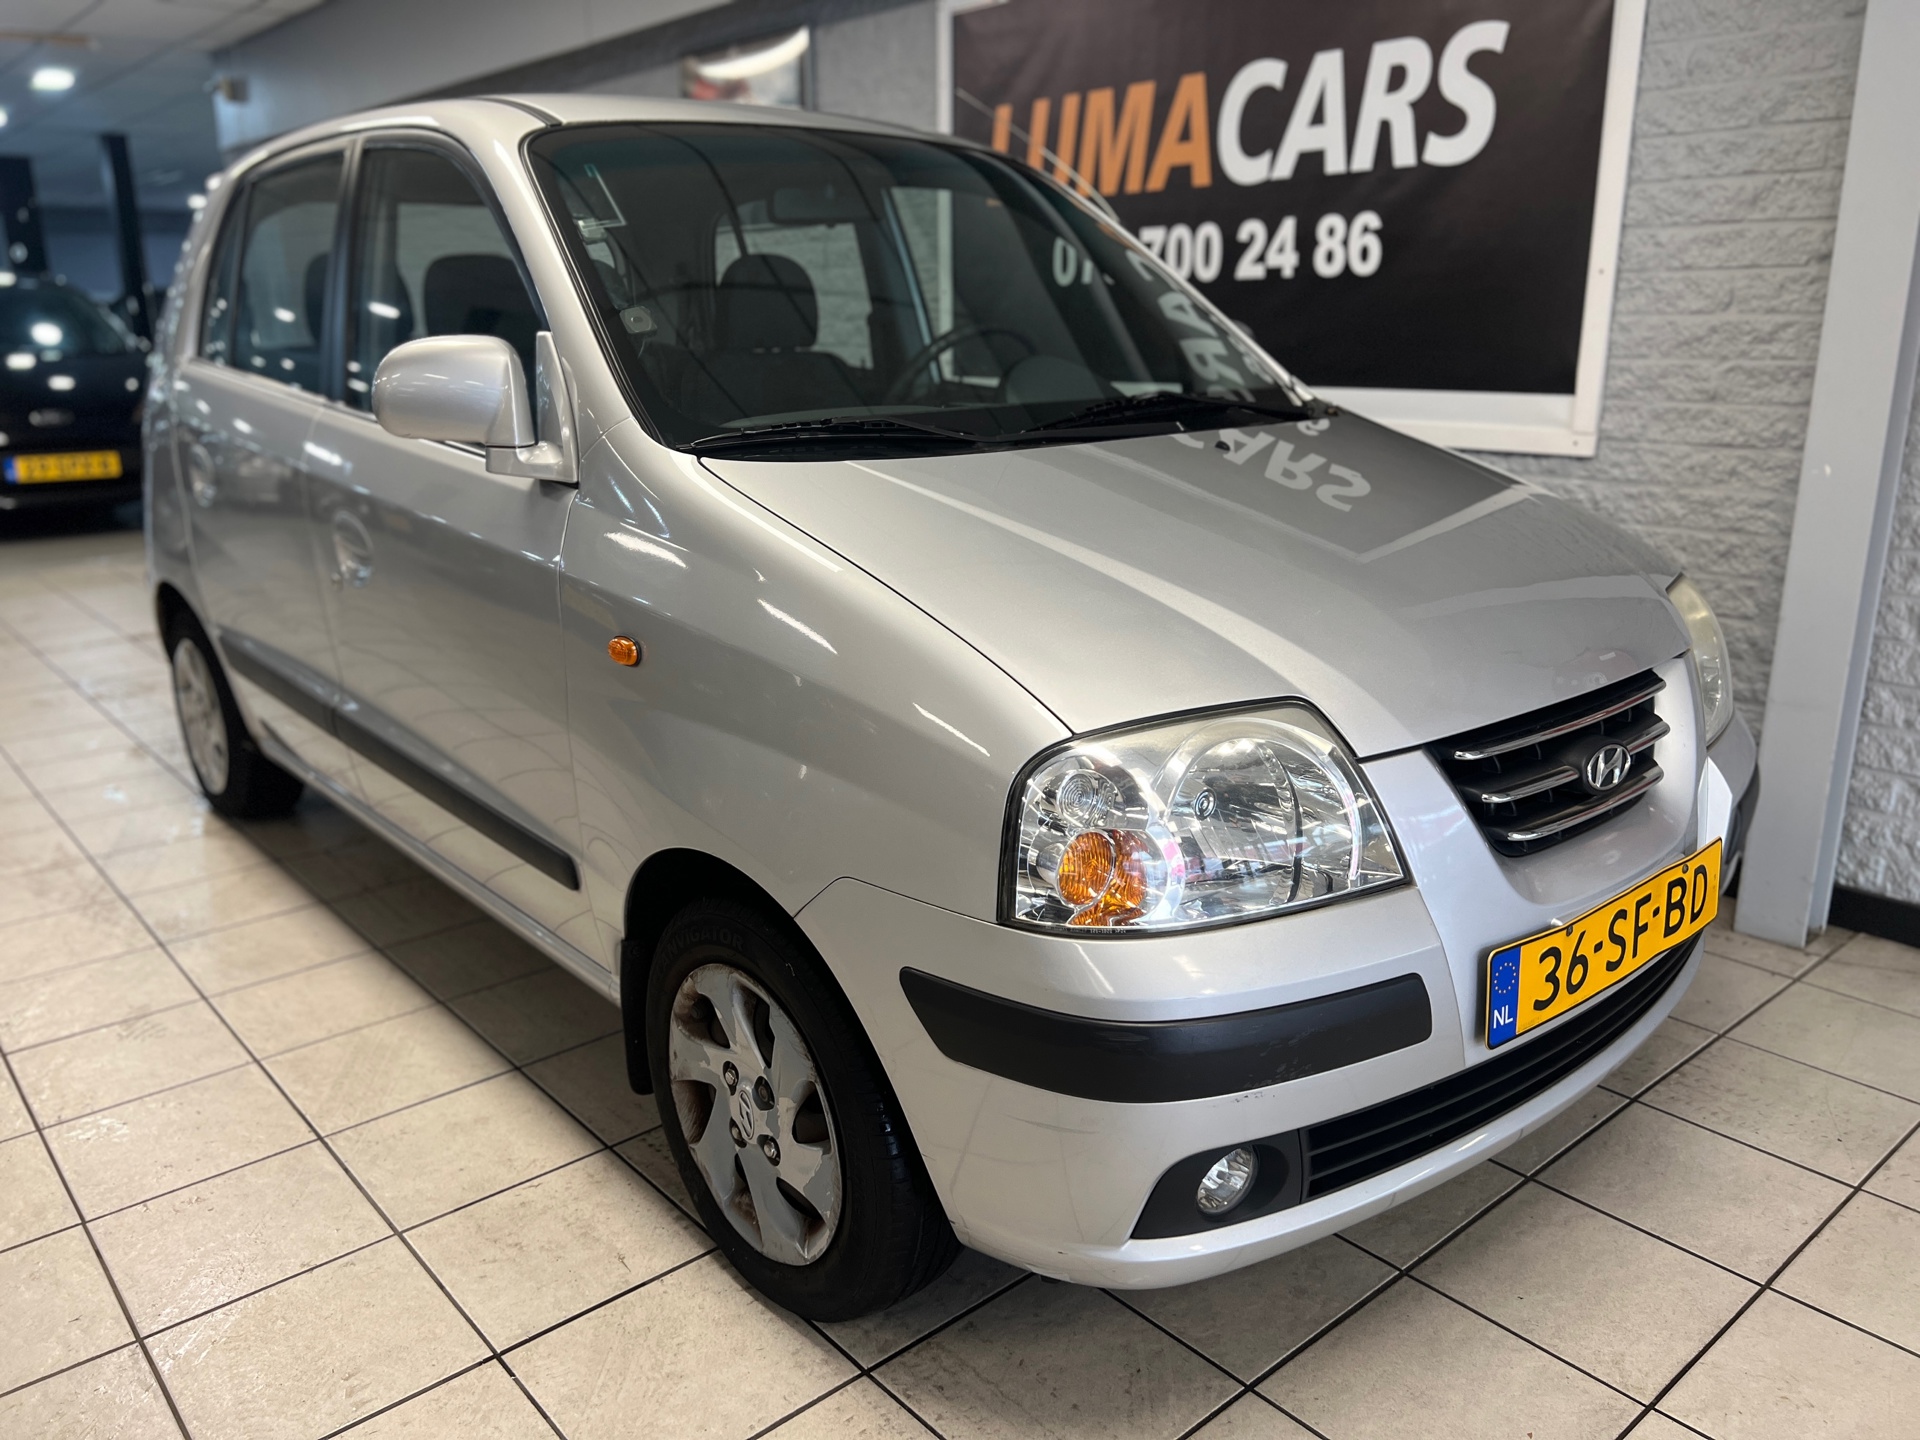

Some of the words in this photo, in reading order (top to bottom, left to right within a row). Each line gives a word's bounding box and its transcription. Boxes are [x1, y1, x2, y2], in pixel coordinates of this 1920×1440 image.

[1233, 216, 1300, 282] 24
[1312, 209, 1384, 279] 86
[1532, 864, 1708, 1012] 36-SF-BD
[1493, 1004, 1514, 1030] NL
